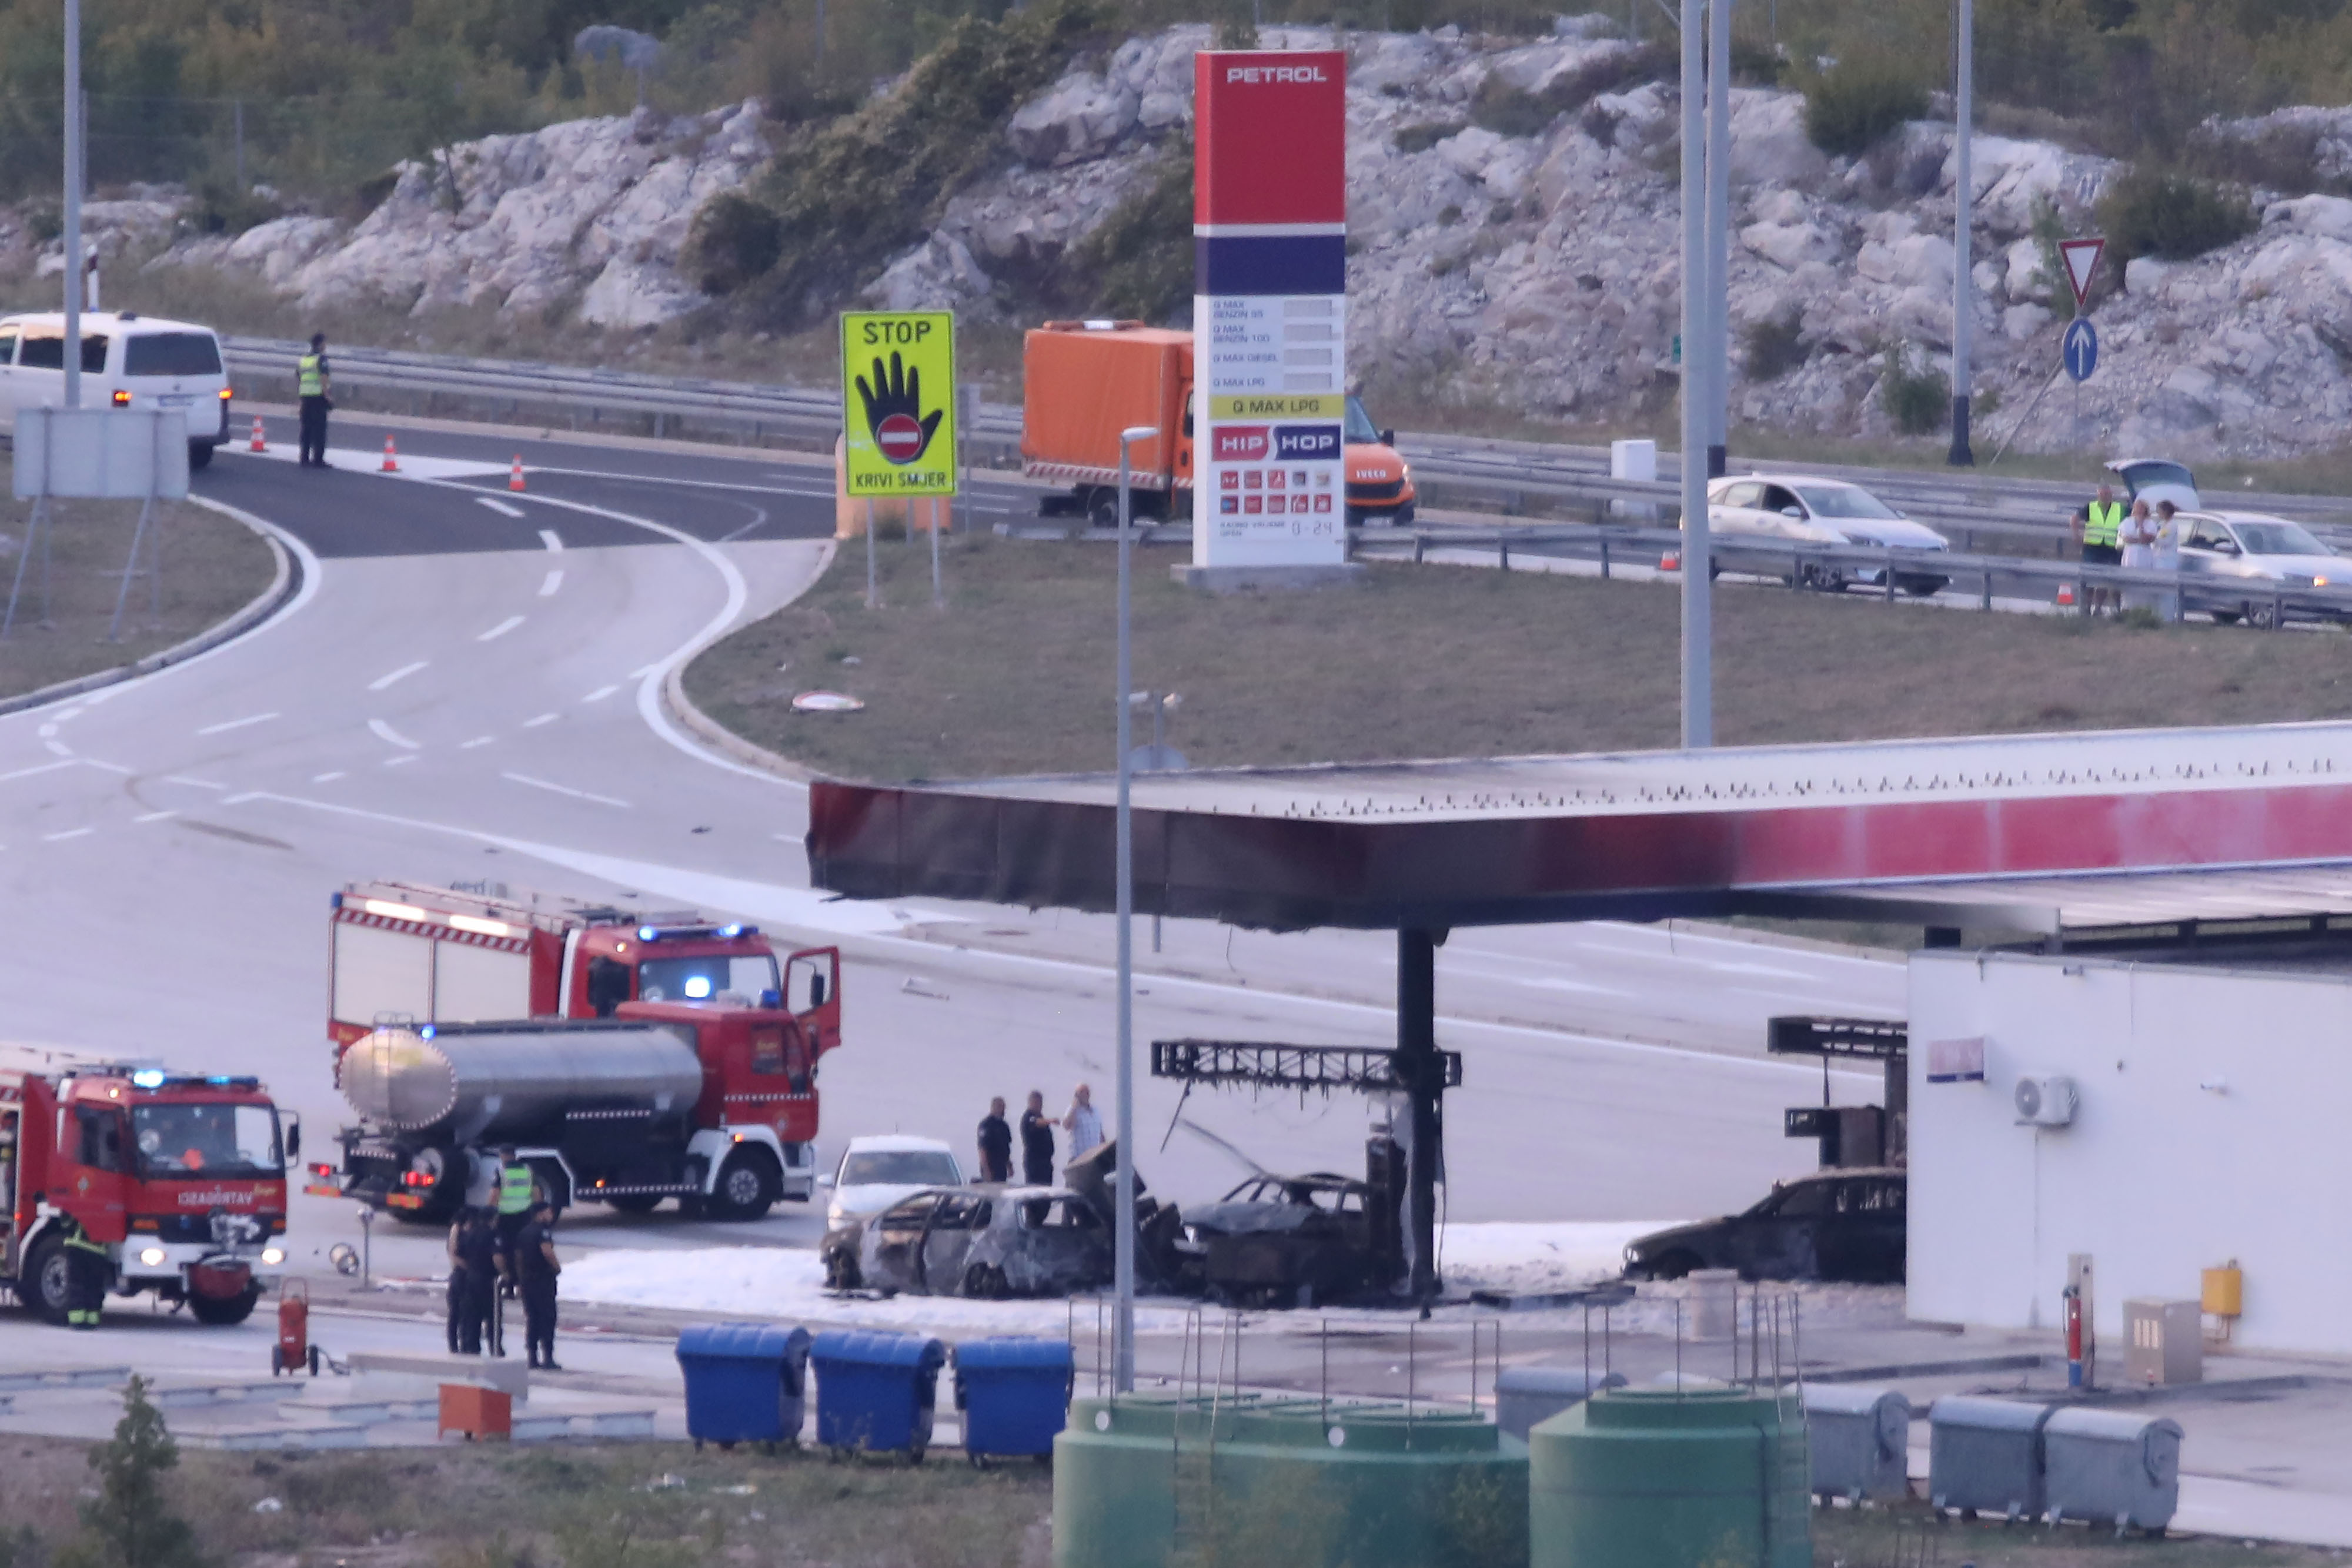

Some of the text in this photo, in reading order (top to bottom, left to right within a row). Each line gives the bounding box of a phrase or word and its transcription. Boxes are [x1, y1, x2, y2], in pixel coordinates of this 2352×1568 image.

[1227, 66, 1327, 83] PETROL
[1223, 300, 1245, 309] MAX
[863, 320, 931, 345] STOP
[1223, 325, 1245, 333] MAX
[1223, 353, 1244, 362] MAX
[1223, 378, 1244, 386] MAX
[1247, 377, 1265, 386] LPG
[1232, 399, 1320, 414] Q MAX LPG
[1221, 434, 1334, 452] HIP HOP
[856, 471, 946, 488] KRIVI SMJER
[1356, 469, 1387, 479] IVECO
